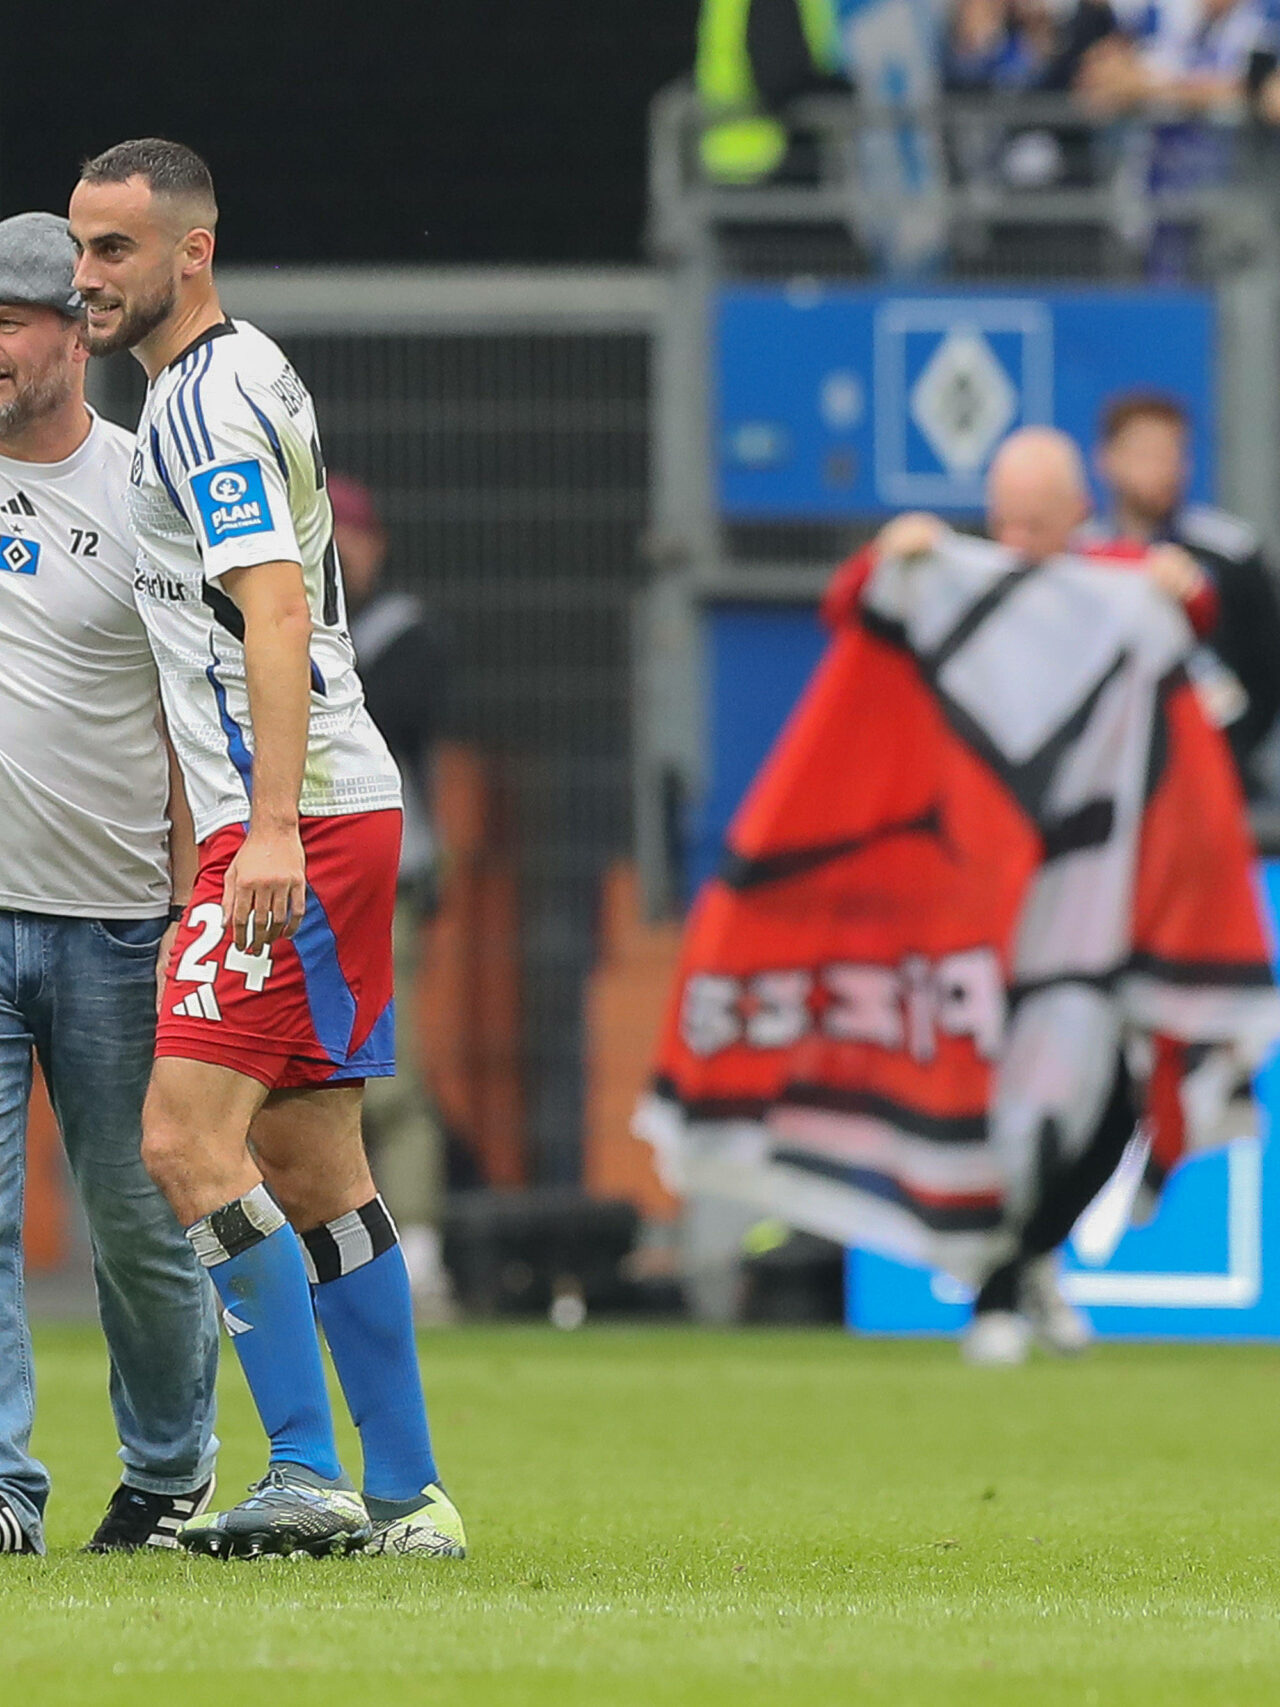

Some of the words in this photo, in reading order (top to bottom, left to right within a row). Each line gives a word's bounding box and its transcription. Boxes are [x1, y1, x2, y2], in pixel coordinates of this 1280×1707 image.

[211, 501, 261, 528] PLAN
[70, 527, 99, 557] 72
[175, 902, 273, 992] 24
